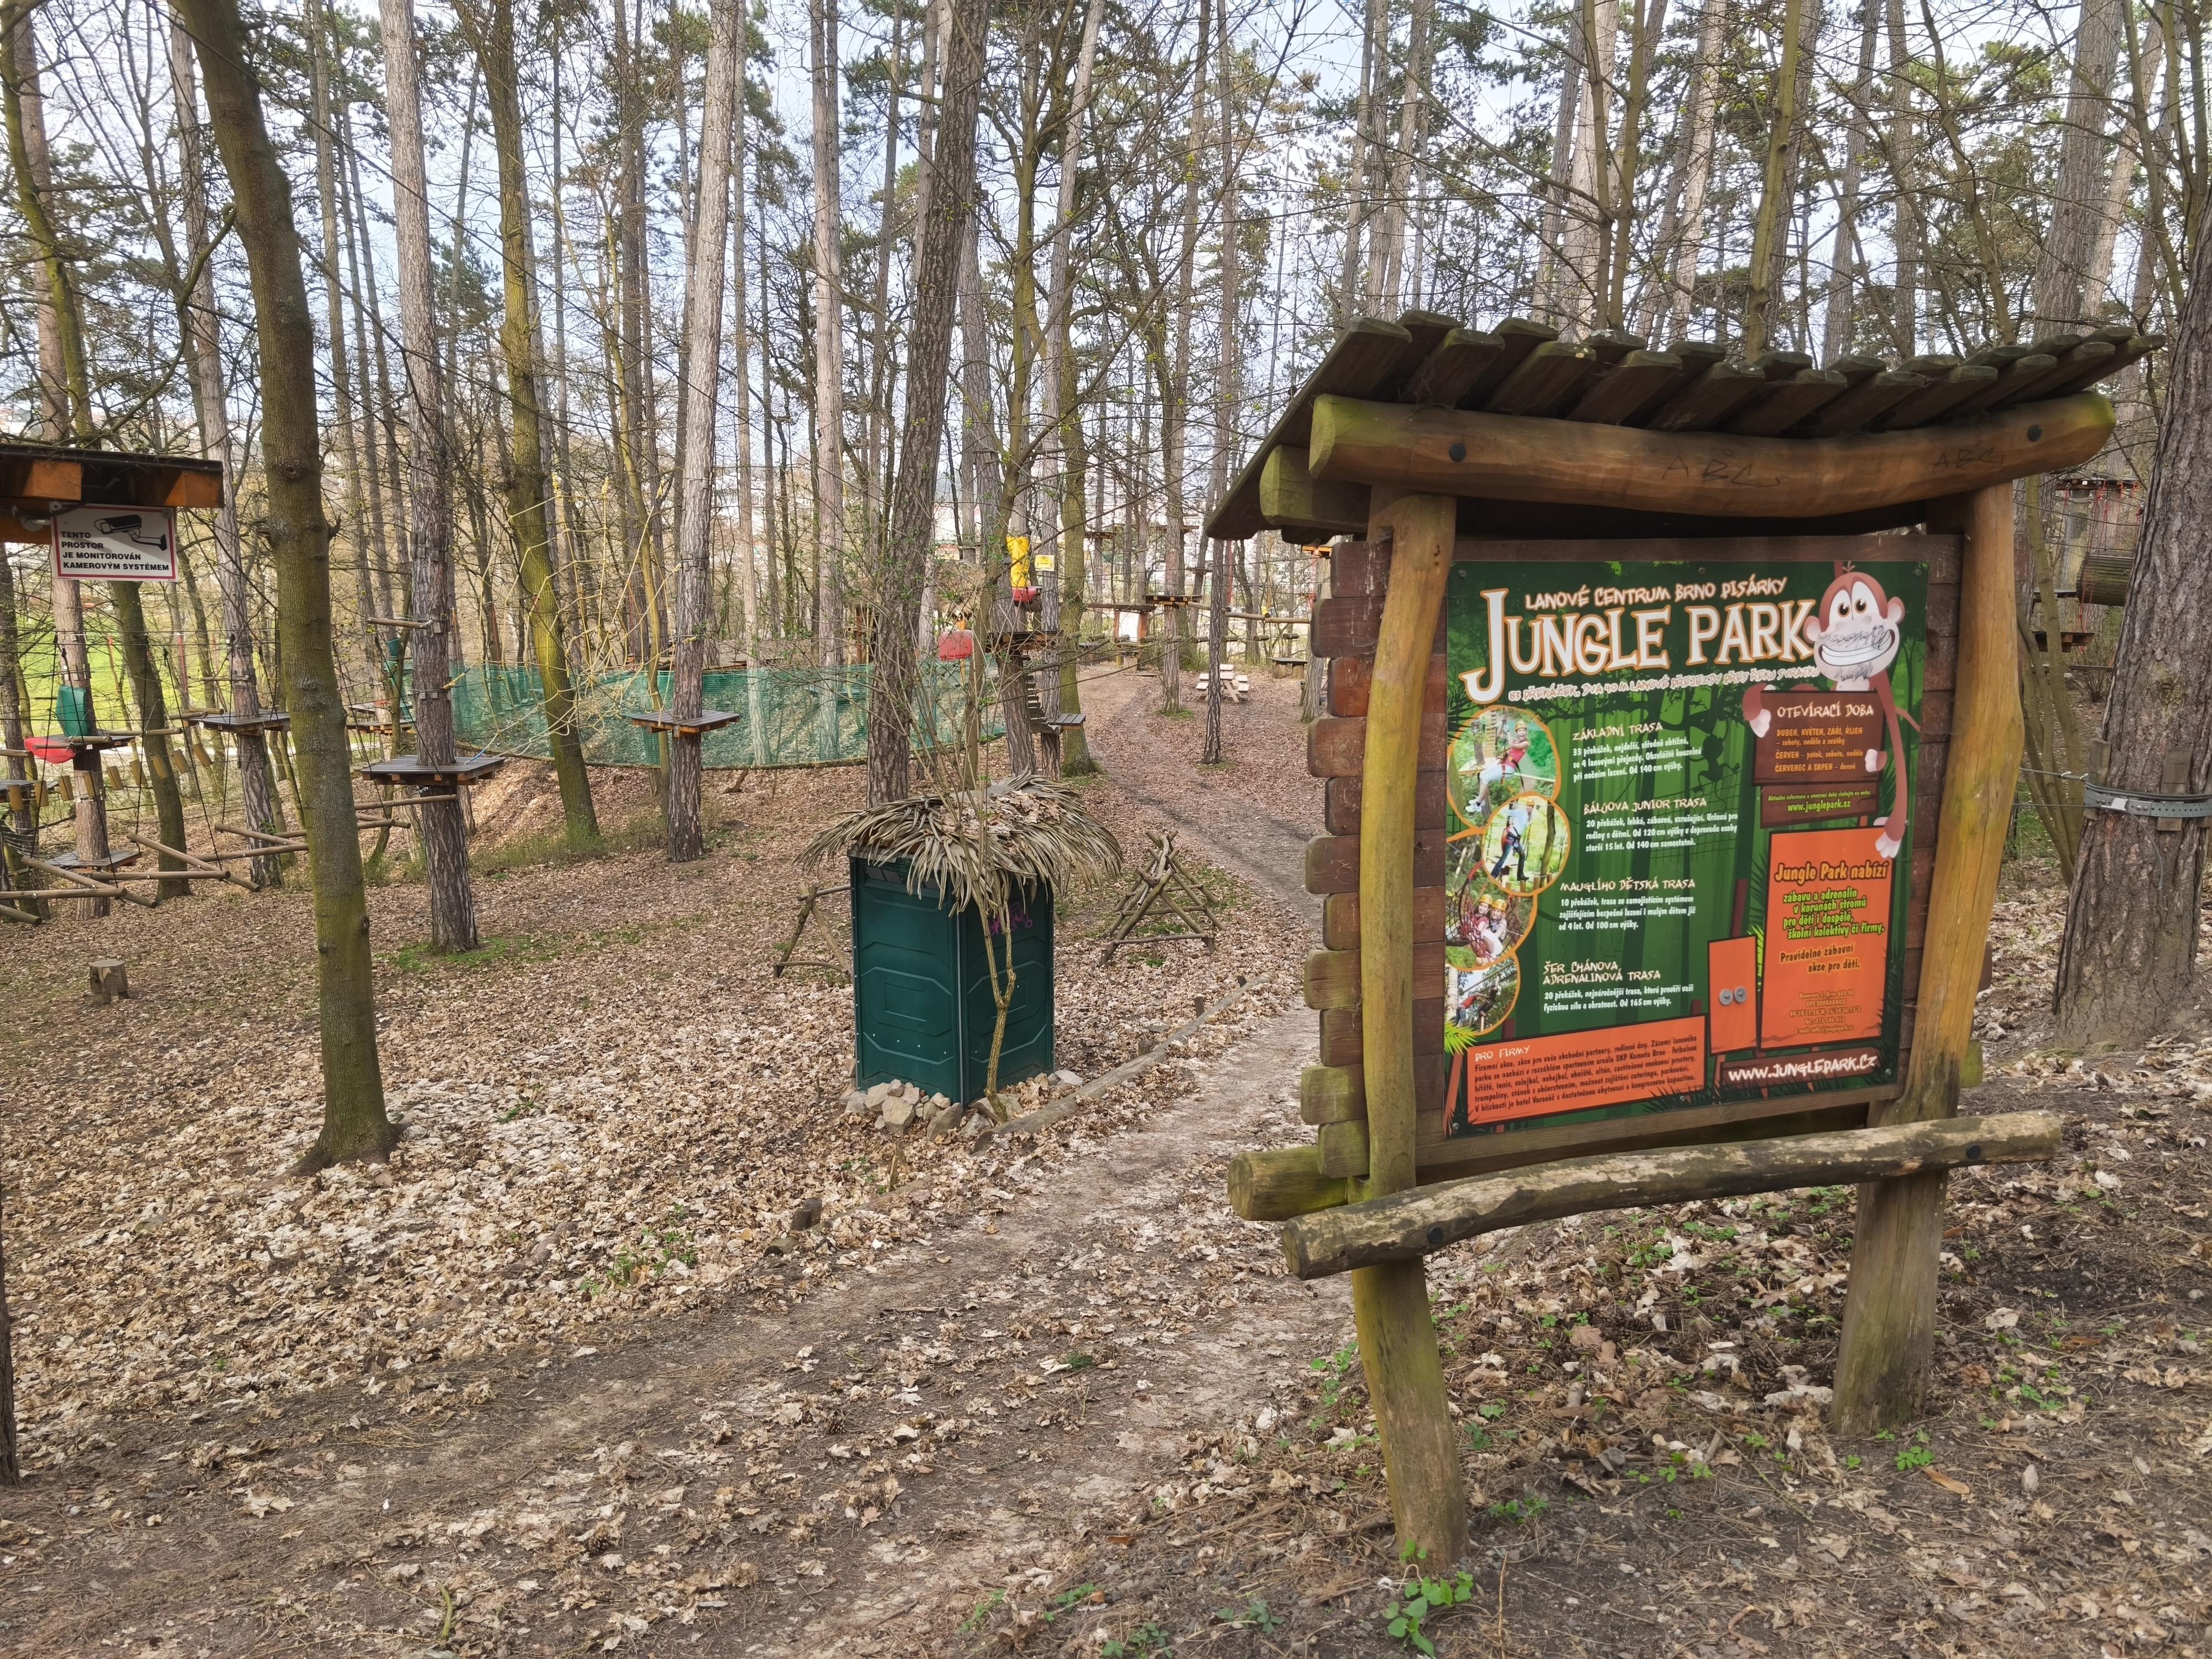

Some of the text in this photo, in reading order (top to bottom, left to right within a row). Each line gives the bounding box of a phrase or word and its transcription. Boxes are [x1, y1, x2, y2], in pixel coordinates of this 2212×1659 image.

[76, 552, 141, 560] MONITOROVÁN
[123, 562, 169, 571] SYSTÉMEM
[1525, 573, 1787, 609] LANOVÉ CENTRUM BRNO PISÁRKY
[1458, 588, 1816, 705] JUNGLE PARK
[1508, 665, 1819, 702] 83 PŘEKÁŽEK, DVA 40 M LANOVÉ PŘEJEZDY PŘES ŘEKU SVRATKU
[1777, 701, 1874, 718] OTEVÍRACÍ DOBA
[1572, 722, 1663, 741] ZÁKLADNÍ TRASA
[1776, 726, 1863, 737] DUBEN, KVĚTEN, ŘÍJEN
[1583, 744, 1612, 757] překážek,
[1614, 742, 1640, 753] nejdelší,
[1641, 739, 1663, 749] středně
[1665, 736, 1688, 746] obtížná,
[1828, 737, 1845, 746] svátky
[1588, 757, 1615, 767] lanovými
[1616, 753, 1644, 765] přejezdy.
[1676, 747, 1701, 757] kouzelná
[1775, 749, 1799, 759] ČERVEN
[1573, 774, 1582, 782] při
[1584, 770, 1606, 780] nočním
[1608, 768, 1627, 777] lezení.
[1629, 766, 1637, 775] Od
[1640, 765, 1652, 773] 140
[1663, 761, 1682, 771] výšky.
[1775, 763, 1806, 773] ČERVENEC
[1584, 797, 1707, 815] BÁLÚOVA JUNIOR TRASA
[1787, 799, 1850, 813] www.junglepark.cz
[1586, 820, 1595, 828] 20
[1597, 817, 1625, 829] překážek,
[1627, 816, 1645, 826] lehká,
[1647, 815, 1672, 824] zábavná,
[1674, 814, 1704, 823] vzrušující.
[1586, 823, 1738, 841] rodiny dětmi. Od výšky doprovodu osoby
[1586, 843, 1603, 852] starší
[1614, 842, 1624, 850] let.
[1626, 841, 1635, 849] Od
[1661, 838, 1695, 847] samostatně.
[1775, 859, 1888, 886] Jungle Park nabízí
[1560, 876, 1695, 893] MAUGLÍHO DĚTSKÁ TRASA
[1571, 898, 1599, 908] překážek,
[1626, 895, 1663, 906] samojistícím
[1665, 895, 1693, 905] systémem
[1783, 886, 1858, 903] zábavu a adrenalin
[1559, 906, 1696, 920] zajišťujícím bezpečné lezení malým dětem již
[1793, 895, 1867, 914] v korunách stromů
[1558, 922, 1566, 930] od
[1573, 921, 1583, 930] let.
[1585, 921, 1594, 930] Od
[1596, 921, 1608, 929] 100
[1620, 919, 1639, 930] výšky.
[1783, 911, 1853, 930] pro děti dospělé,
[1787, 921, 1885, 940] školní kolektivy či firmy.
[1780, 942, 1854, 962] Pravidelné zábavní
[1543, 958, 1618, 974] ŠER CHÁNOVA
[1808, 958, 1860, 973] akce pro děti.
[1543, 968, 1661, 985] ADRENALINOVÁ TRASA
[1554, 989, 1583, 1000] překážek,
[1584, 987, 1625, 999] nejnáročnější
[1625, 987, 1642, 995] trasa,
[1644, 985, 1659, 994] která
[1543, 1002, 1568, 1013] fyzickou
[1570, 1001, 1581, 1010] sílu
[1588, 1000, 1618, 1009] obratnost.
[1620, 999, 1628, 1007] Od
[1653, 997, 1672, 1006] výšky.
[1475, 1045, 1530, 1062] PRO FIRMY
[1475, 1062, 1498, 1072] Firemní
[1558, 1050, 1584, 1060] obchodní
[1475, 1053, 1627, 1083] parku SKP
[1516, 1097, 1530, 1106] hotel
